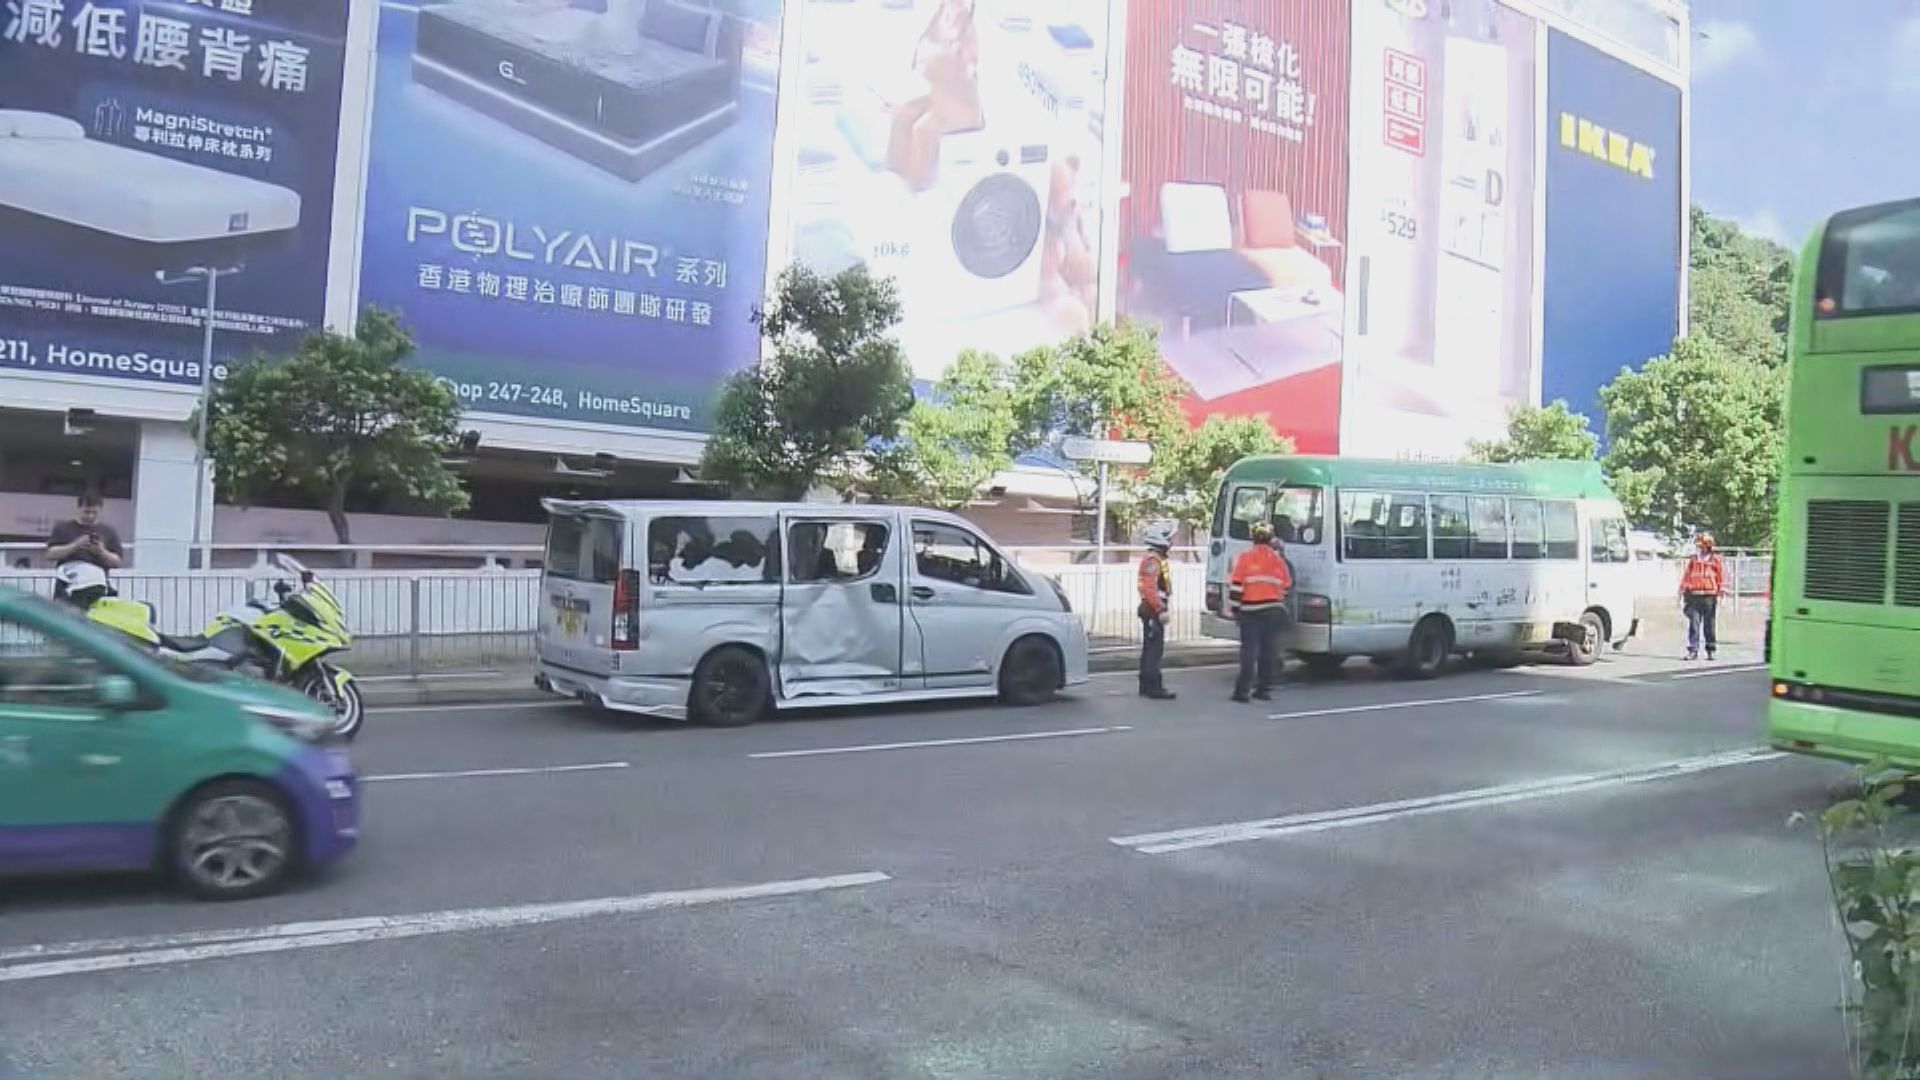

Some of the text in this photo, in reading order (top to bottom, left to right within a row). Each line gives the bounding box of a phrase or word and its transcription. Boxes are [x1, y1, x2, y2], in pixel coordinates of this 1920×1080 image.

[4, 0, 311, 92] 減低腰背痛
[1171, 43, 1316, 127] 無限可能!
[1559, 111, 1656, 179] IKEA
[418, 263, 713, 326] 香港物理治療師團隊研發
[675, 256, 728, 288] 系列
[578, 391, 691, 421] HomeSquare
